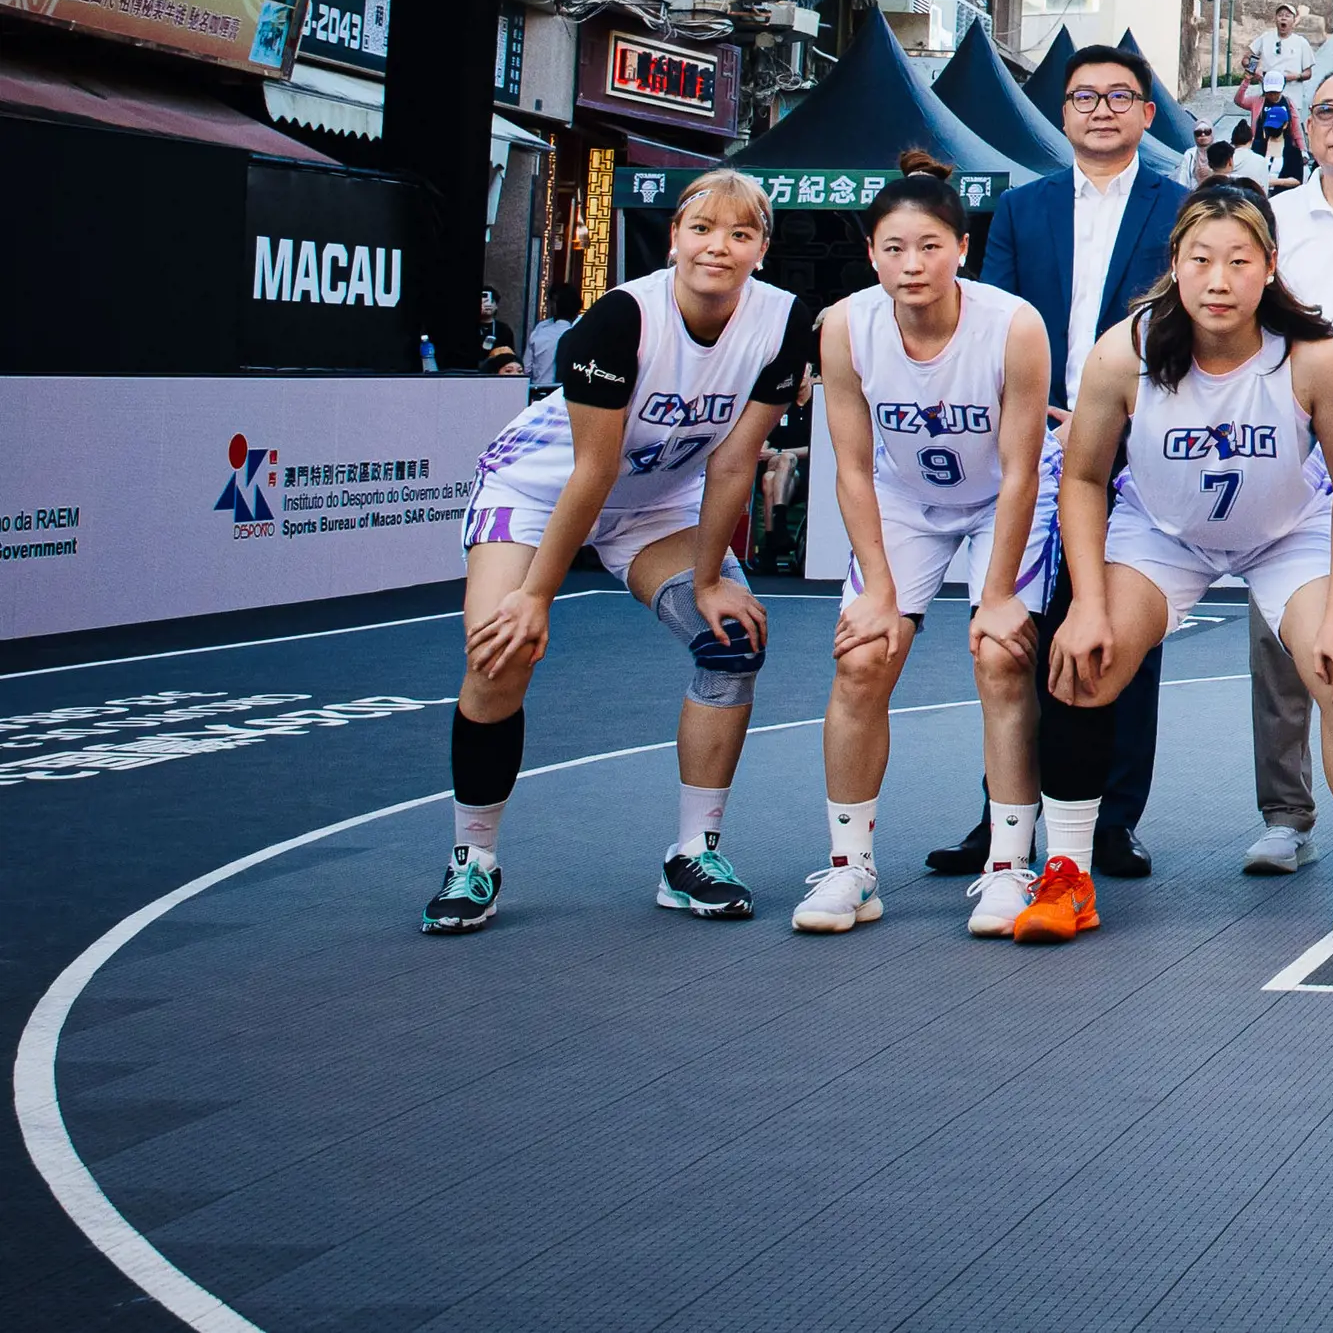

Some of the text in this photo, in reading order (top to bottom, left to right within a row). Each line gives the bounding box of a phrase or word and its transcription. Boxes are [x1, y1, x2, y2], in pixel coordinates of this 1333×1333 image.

[253, 235, 402, 308] MACAU
[284, 458, 430, 488] 澳門特別行政區政府體育局
[916, 445, 967, 488] 9
[283, 490, 325, 512] Instituto
[326, 489, 339, 508] do
[342, 487, 385, 511] Desporto
[386, 486, 399, 504] do
[401, 484, 439, 503] Governo
[441, 483, 453, 499] da
[1200, 469, 1245, 522] 7
[14, 510, 32, 532] da
[36, 507, 80, 530] RAEM
[282, 518, 317, 537] Sports
[320, 516, 356, 533] Bureau
[359, 513, 369, 529] of
[371, 511, 402, 529] Macao
[404, 509, 425, 525] SAR
